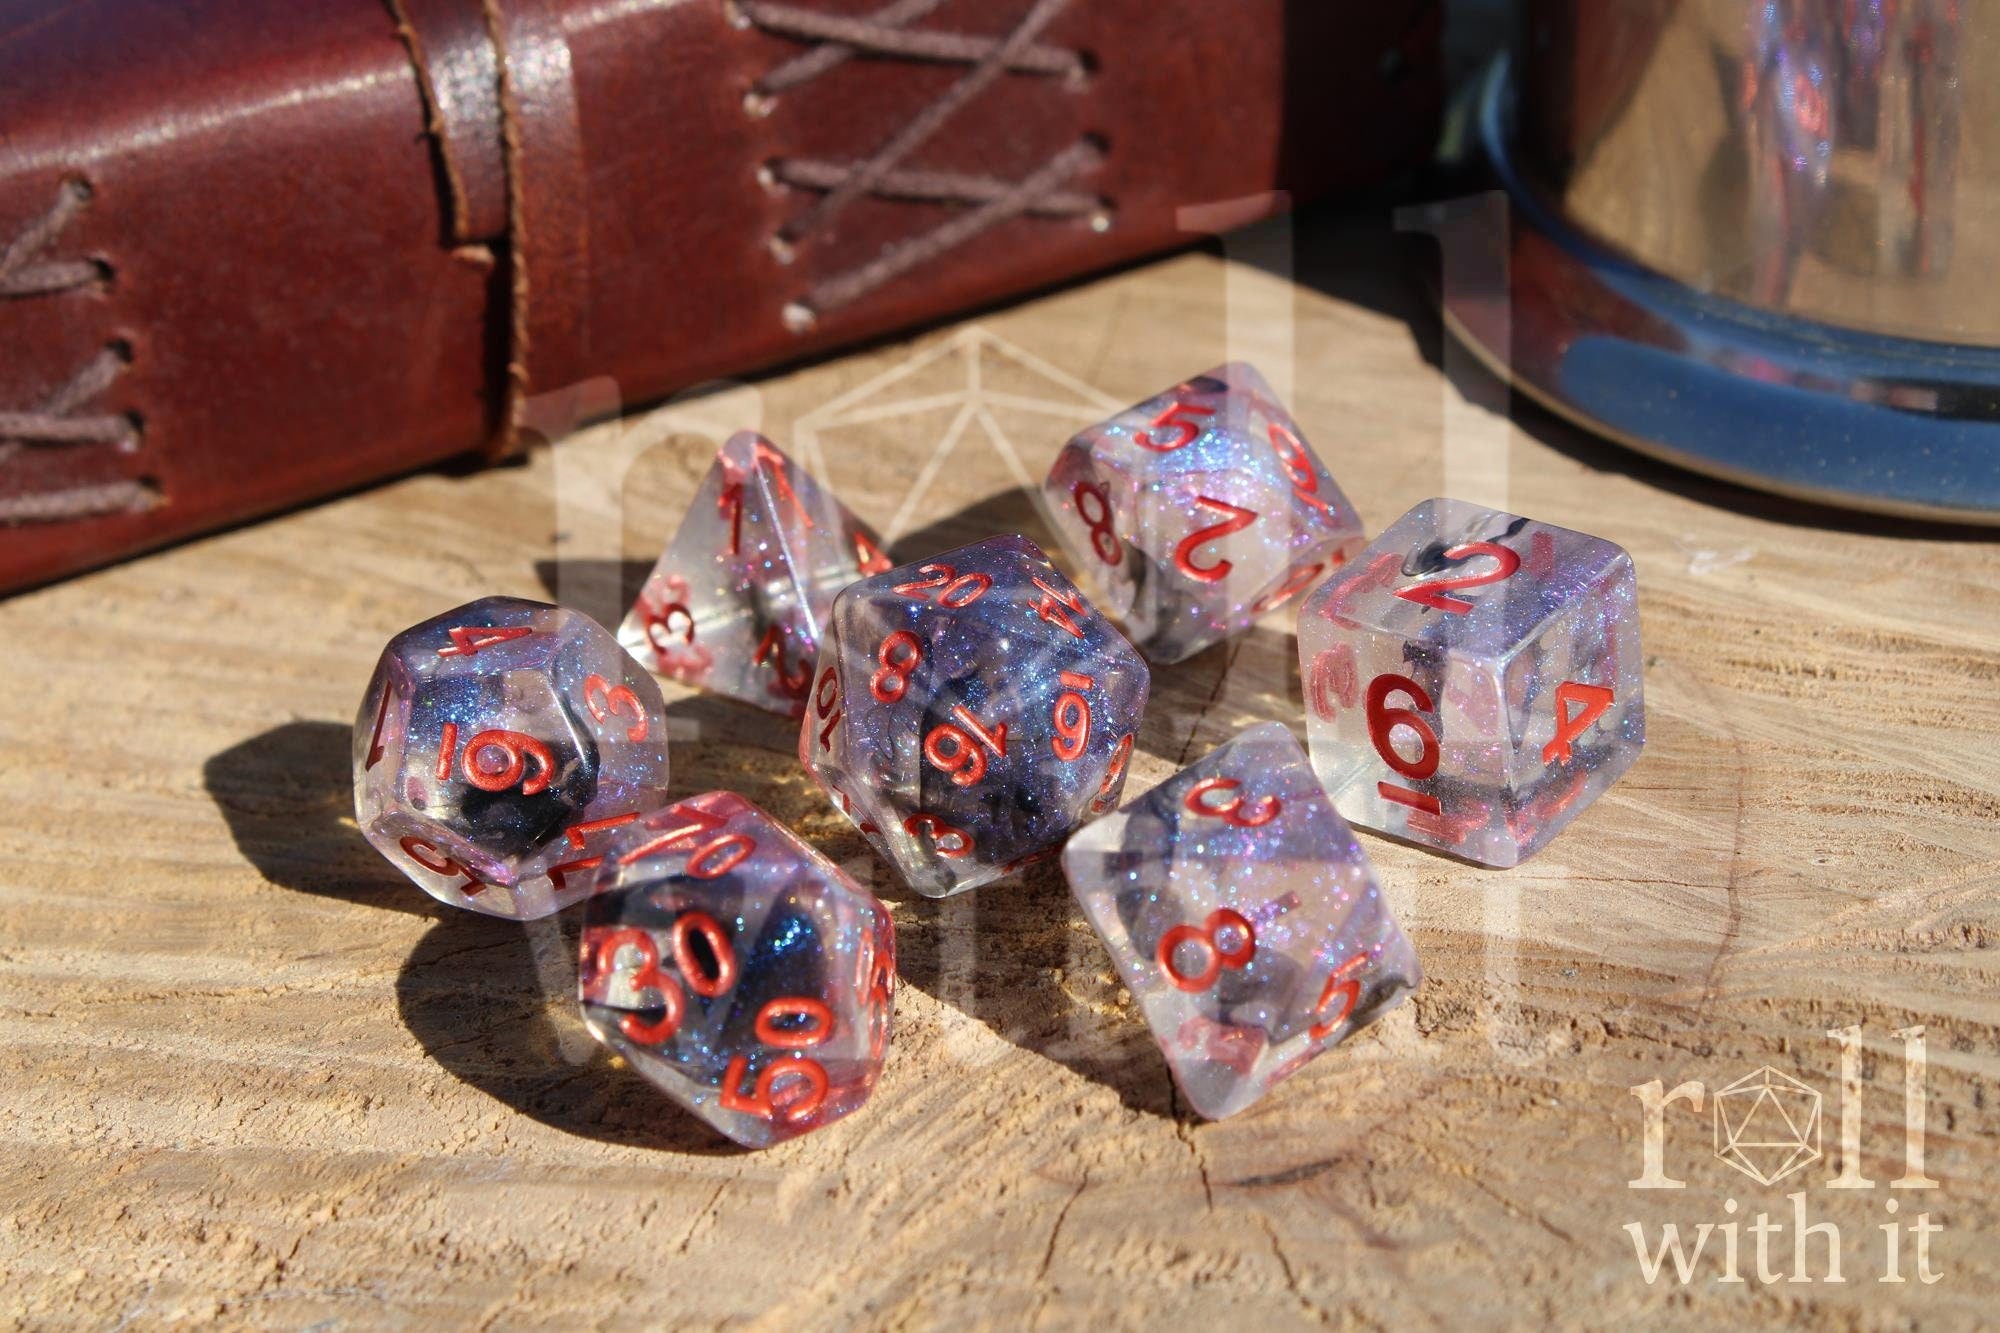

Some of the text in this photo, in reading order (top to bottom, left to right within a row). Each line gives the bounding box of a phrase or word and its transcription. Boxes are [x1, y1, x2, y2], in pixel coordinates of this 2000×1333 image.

[1134, 401, 1217, 452] 5
[1073, 482, 1122, 566] 8
[1174, 496, 1259, 582] 2
[892, 563, 993, 608] 20
[1392, 541, 1522, 614] 2
[437, 626, 533, 658] 4
[870, 629, 922, 703] 8
[583, 673, 649, 743] 3
[1366, 673, 1440, 781] 6
[1542, 681, 1614, 766] 4
[1185, 777, 1282, 827] 3
[597, 910, 737, 1046] 30
[1156, 908, 1256, 994] 8
[1309, 951, 1368, 1040] 5
